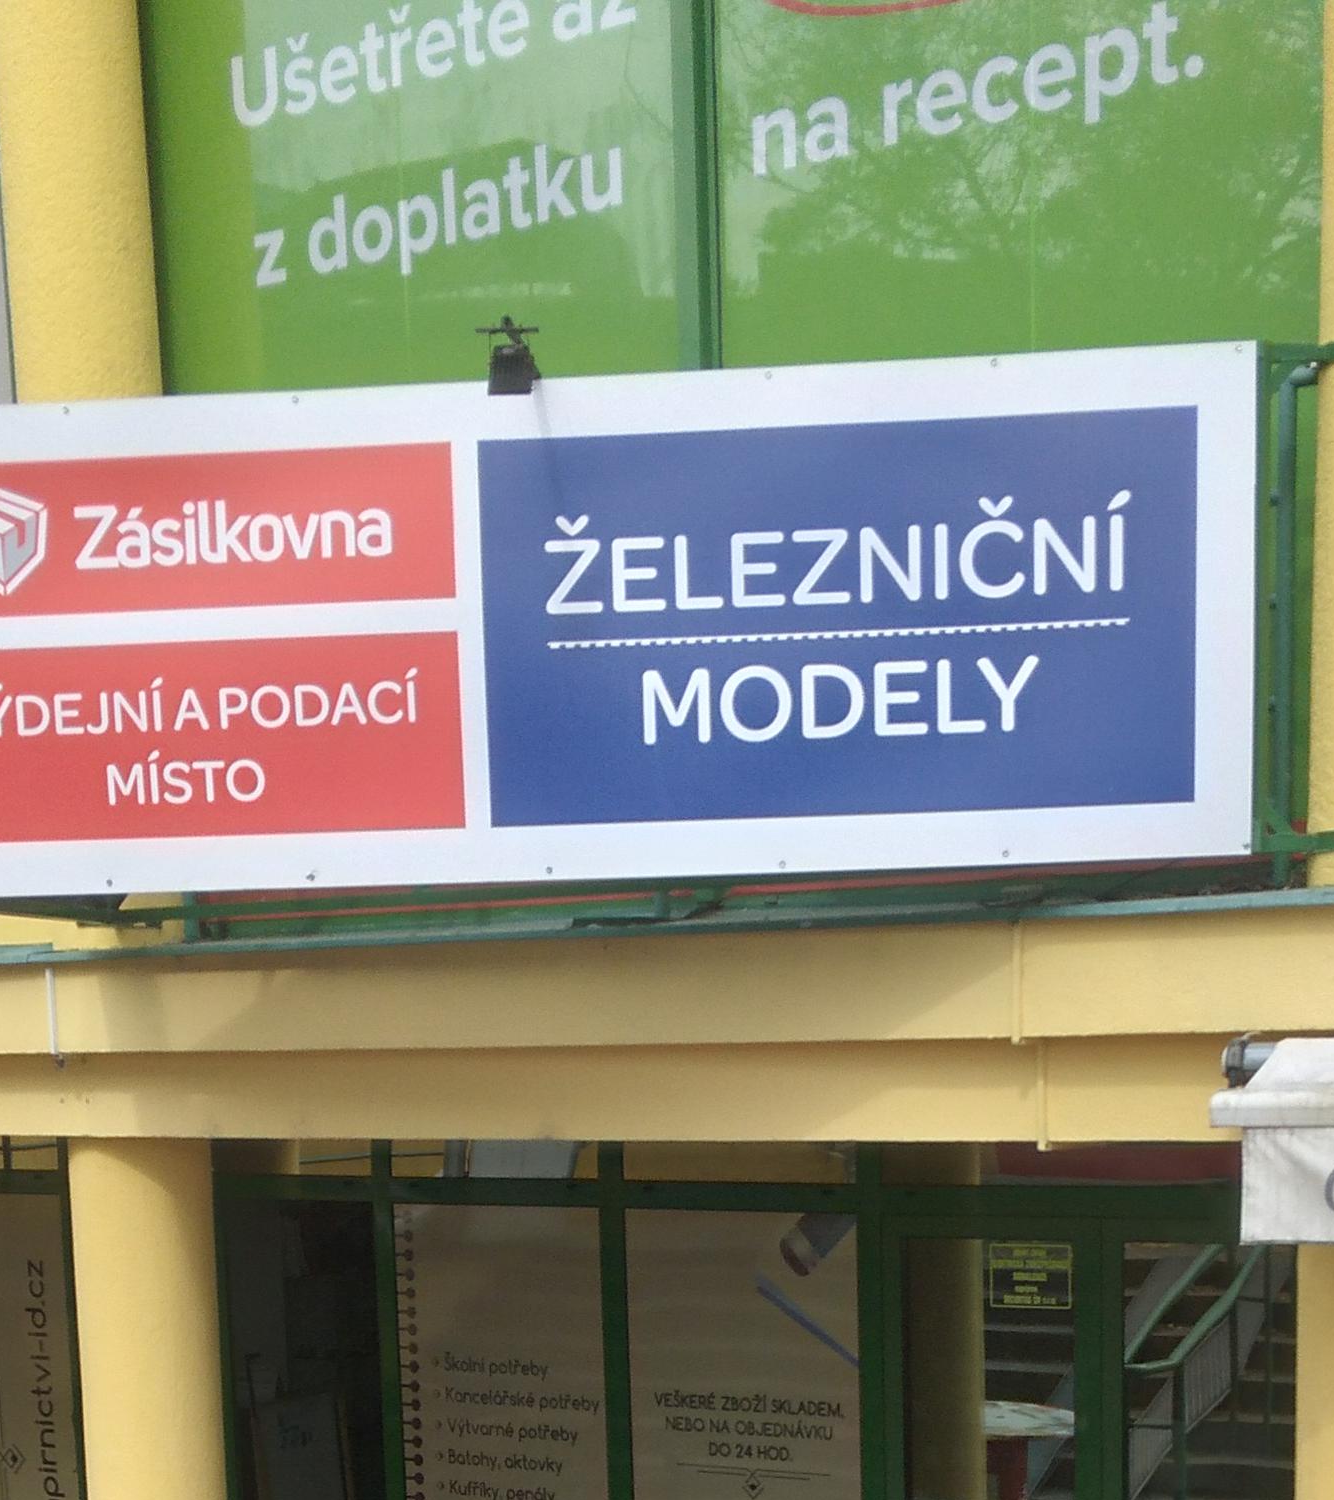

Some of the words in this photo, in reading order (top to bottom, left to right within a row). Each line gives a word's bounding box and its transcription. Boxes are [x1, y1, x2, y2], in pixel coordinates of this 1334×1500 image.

[230, 0, 529, 127] Ušetřete
[751, 97, 849, 176] na
[883, 2, 1204, 146] recept.
[254, 228, 288, 287] z
[308, 144, 624, 276] doplatku
[74, 500, 393, 570] Zásilkovna
[544, 489, 1131, 615] ŽELEZNIČNÍ
[175, 690, 210, 732] A
[220, 667, 419, 729] PODACÍ
[642, 655, 1039, 746] MODELY
[106, 750, 266, 806] MÍSTO
[489, 1359, 549, 1380] potřeby
[444, 1387, 535, 1409] Kancelářské
[539, 1395, 600, 1415] potřeby
[654, 1390, 717, 1410] VEŠKERÉ
[721, 1394, 767, 1413] ZBOŽÍ
[665, 1416, 705, 1433] NEBO
[709, 1419, 731, 1433] NA
[735, 1420, 834, 1440] OBJEDNÁVKU
[447, 1417, 514, 1438] Výtvarné
[518, 1424, 578, 1446] potřeby
[708, 1442, 731, 1458] DO
[735, 1444, 753, 1459] 24
[756, 1446, 794, 1462] HOD.
[504, 1457, 563, 1476] aktovky
